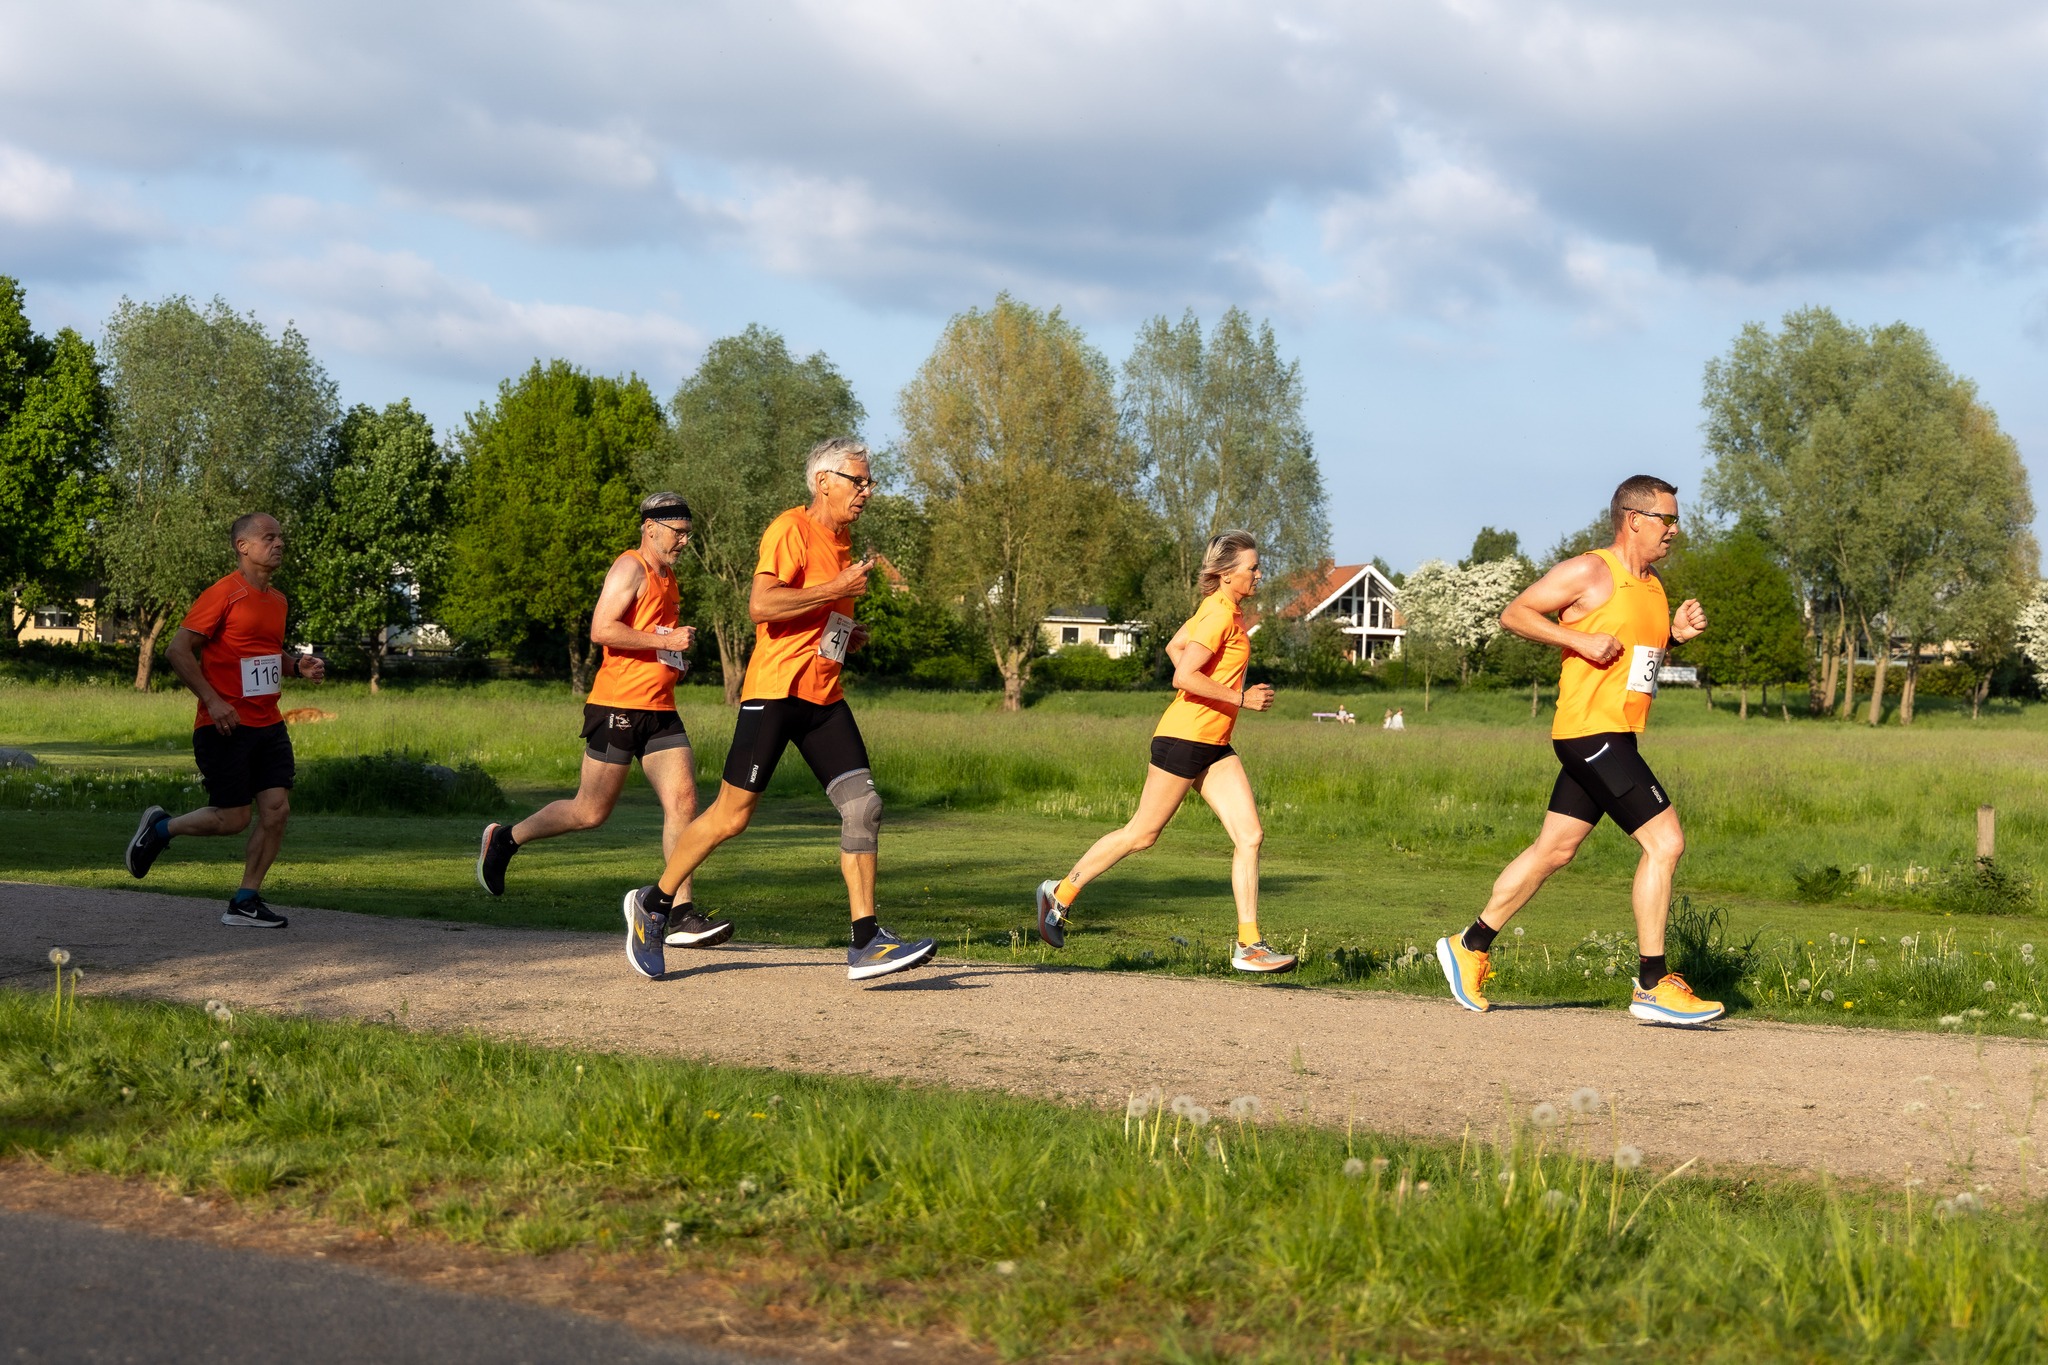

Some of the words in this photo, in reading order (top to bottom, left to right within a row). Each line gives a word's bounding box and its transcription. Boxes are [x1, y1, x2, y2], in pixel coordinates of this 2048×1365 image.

[831, 628, 849, 652] 47
[251, 665, 279, 686] 116
[1650, 785, 1664, 803] FUSION
[1634, 991, 1657, 1003] HOKA
